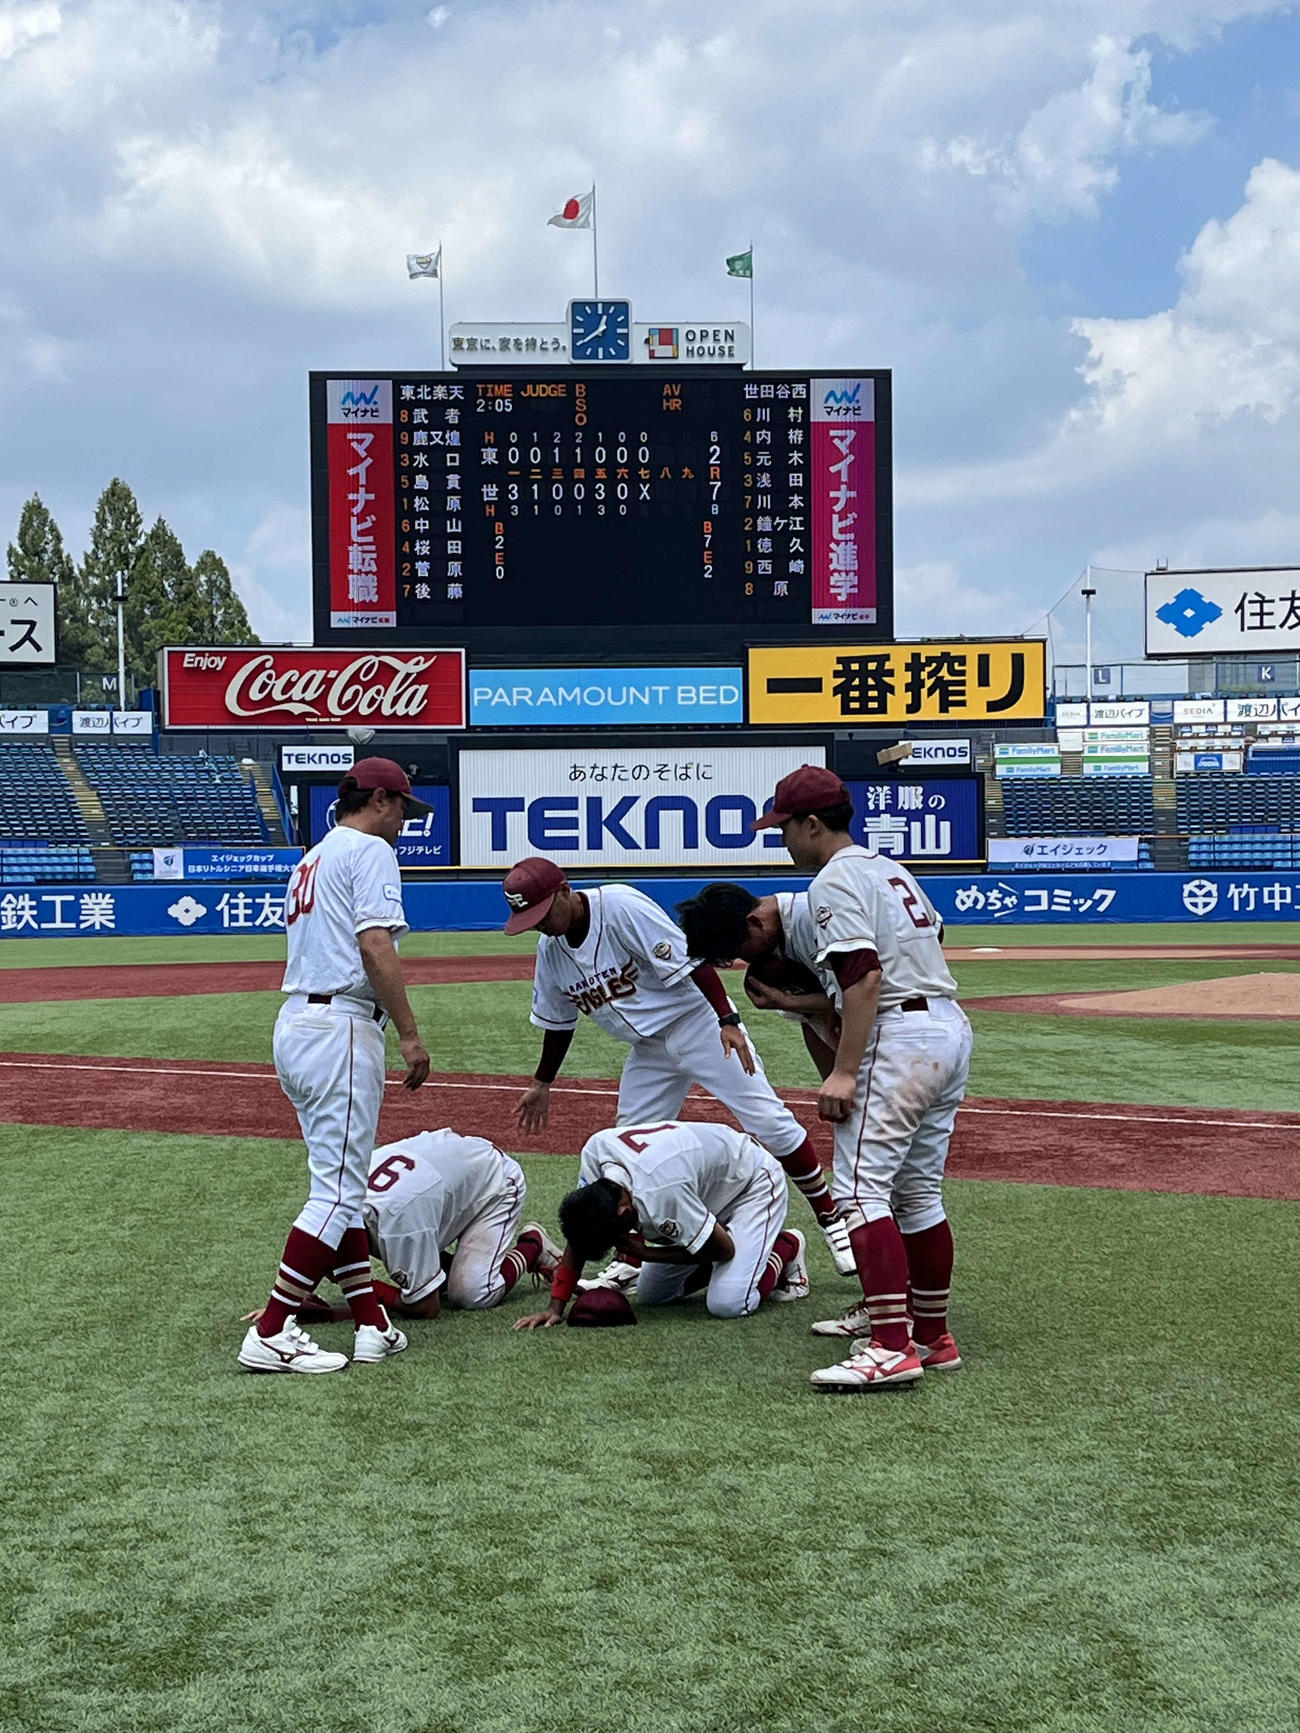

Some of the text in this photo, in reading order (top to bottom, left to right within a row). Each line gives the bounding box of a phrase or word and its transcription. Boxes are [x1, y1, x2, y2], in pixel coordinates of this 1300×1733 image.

[686, 329, 735, 342] OPEN
[452, 336, 567, 352] 東京に、家を持とう。
[686, 344, 735, 358] HOUSE
[400, 385, 464, 400] 東北楽天
[477, 384, 512, 396] TIME
[521, 384, 566, 396] JUDGE
[664, 385, 680, 395] AV
[744, 384, 806, 399] 世田谷西
[477, 399, 512, 412] 2:05
[664, 399, 681, 410] HR
[824, 406, 861, 416] マイナビ
[342, 408, 379, 417] マイナビ
[401, 408, 460, 424] 8 武者
[744, 407, 803, 422] 6 川村
[401, 432, 408, 444] 9
[485, 432, 493, 443] H
[510, 432, 517, 443] 0
[533, 432, 537, 442] 1
[554, 432, 560, 443] 2
[576, 432, 582, 443] 2
[598, 432, 602, 442] 1
[619, 432, 625, 442] 0
[640, 432, 647, 442] 0
[744, 431, 750, 442] 4
[401, 452, 459, 468] 3 水口
[481, 445, 720, 464] 東 0 0 1 1 0 0 0 2
[745, 450, 803, 466] 5 元木
[661, 468, 670, 478] 八
[683, 467, 693, 478] 九
[711, 467, 720, 479] R
[744, 474, 752, 486] 3
[402, 476, 408, 488] 5
[481, 481, 721, 501] 世 3 1 0 0 3 0 X 7
[404, 496, 461, 512] 1 松原
[745, 494, 804, 509] 7 川本
[346, 431, 379, 604] マイナビ転職
[486, 505, 494, 516] H
[511, 505, 518, 515] 3
[534, 505, 538, 515] 1
[555, 505, 561, 515] 0
[578, 505, 581, 515] 1
[598, 505, 605, 515] 3
[620, 505, 626, 515] 0
[830, 430, 859, 601] マイナビ進学
[402, 518, 462, 533] 6 中山
[495, 522, 503, 534] B
[704, 521, 712, 533] B
[745, 518, 752, 530] 2
[403, 539, 461, 555] 4 桜田
[495, 536, 504, 549] 2
[704, 535, 711, 547] 7
[747, 537, 804, 553] 1 徳久
[496, 553, 504, 567] E
[704, 551, 712, 563] E
[403, 563, 410, 575] 2
[496, 566, 504, 579] 0
[704, 565, 712, 578] 2
[745, 561, 753, 573] 9
[404, 583, 462, 599] 7 後藤
[746, 581, 788, 596] 8 原
[0, 619, 43, 653] ス
[1098, 669, 1108, 682] L
[1261, 667, 1272, 680] K
[102, 678, 117, 690] M
[183, 653, 437, 717] Enjoy Coca-Cola
[766, 652, 1025, 716] 一番搾り
[473, 685, 739, 707] PARAMOUNT BED
[283, 753, 353, 765] TEKNOS
[905, 746, 968, 758] EKNOS
[569, 762, 713, 782] あなたのそばに
[867, 785, 945, 810] 洋服の
[863, 813, 951, 855] 青山
[1037, 844, 1108, 856] エイジェック
[887, 876, 932, 928] 2
[954, 884, 1117, 913] めちゃコミック
[1227, 882, 1300, 911] 竹中
[0, 892, 115, 930] 鉄工業
[216, 892, 286, 928] 住友
